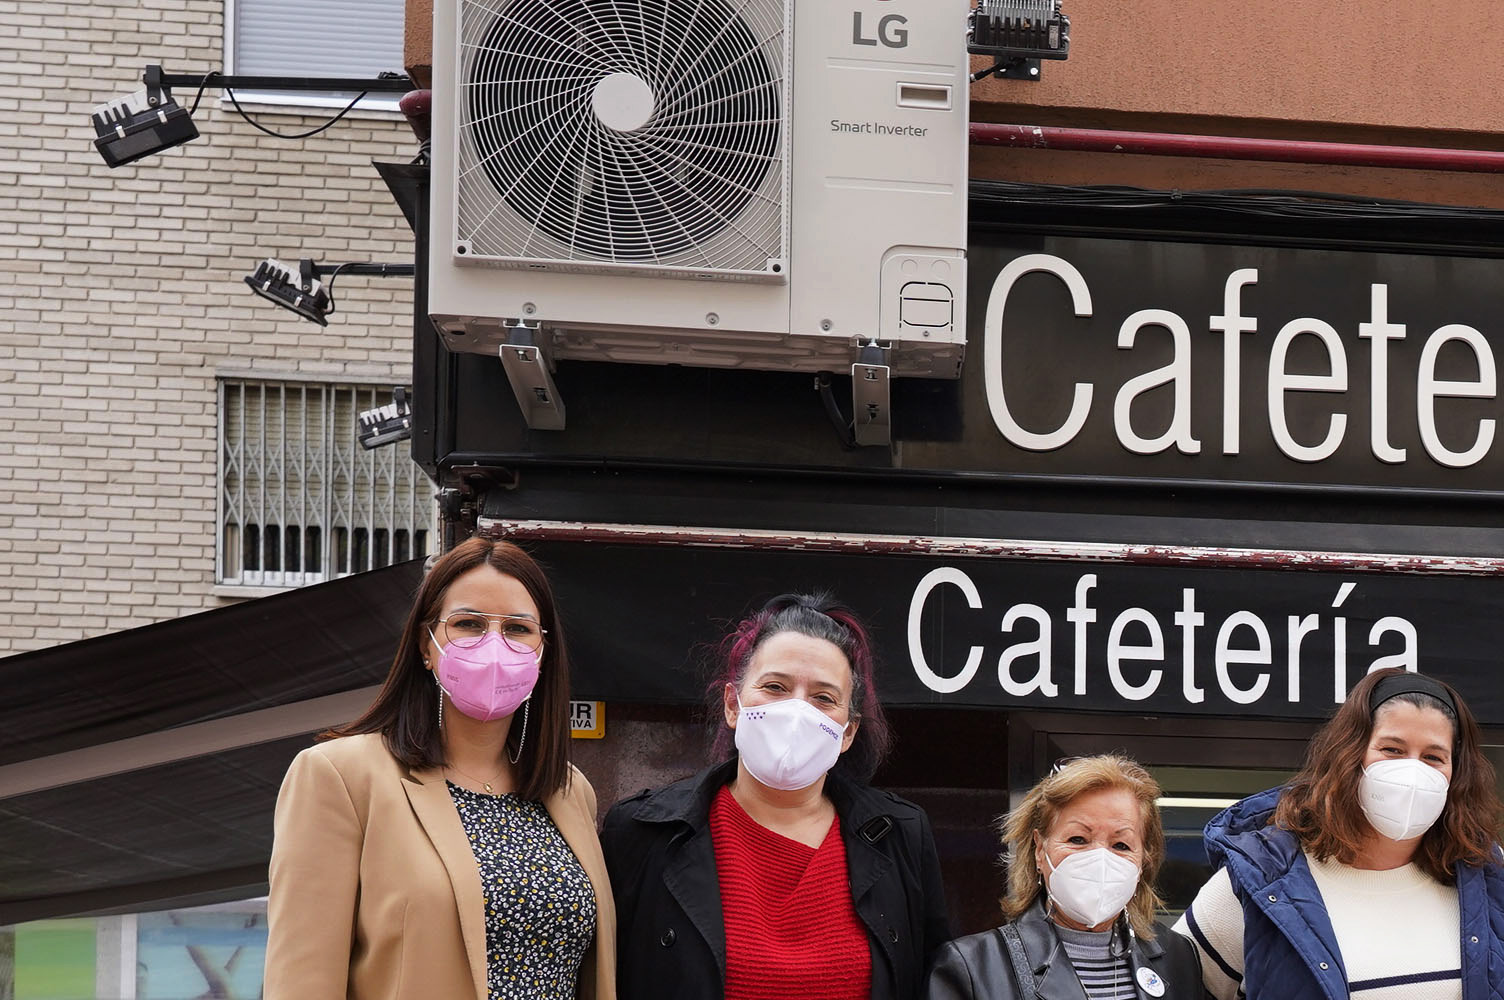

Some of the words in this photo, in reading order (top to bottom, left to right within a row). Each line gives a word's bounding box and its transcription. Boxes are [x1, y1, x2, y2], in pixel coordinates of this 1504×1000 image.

[853, 11, 908, 48] LG
[831, 120, 872, 133] Smart
[874, 122, 928, 137] Inverter
